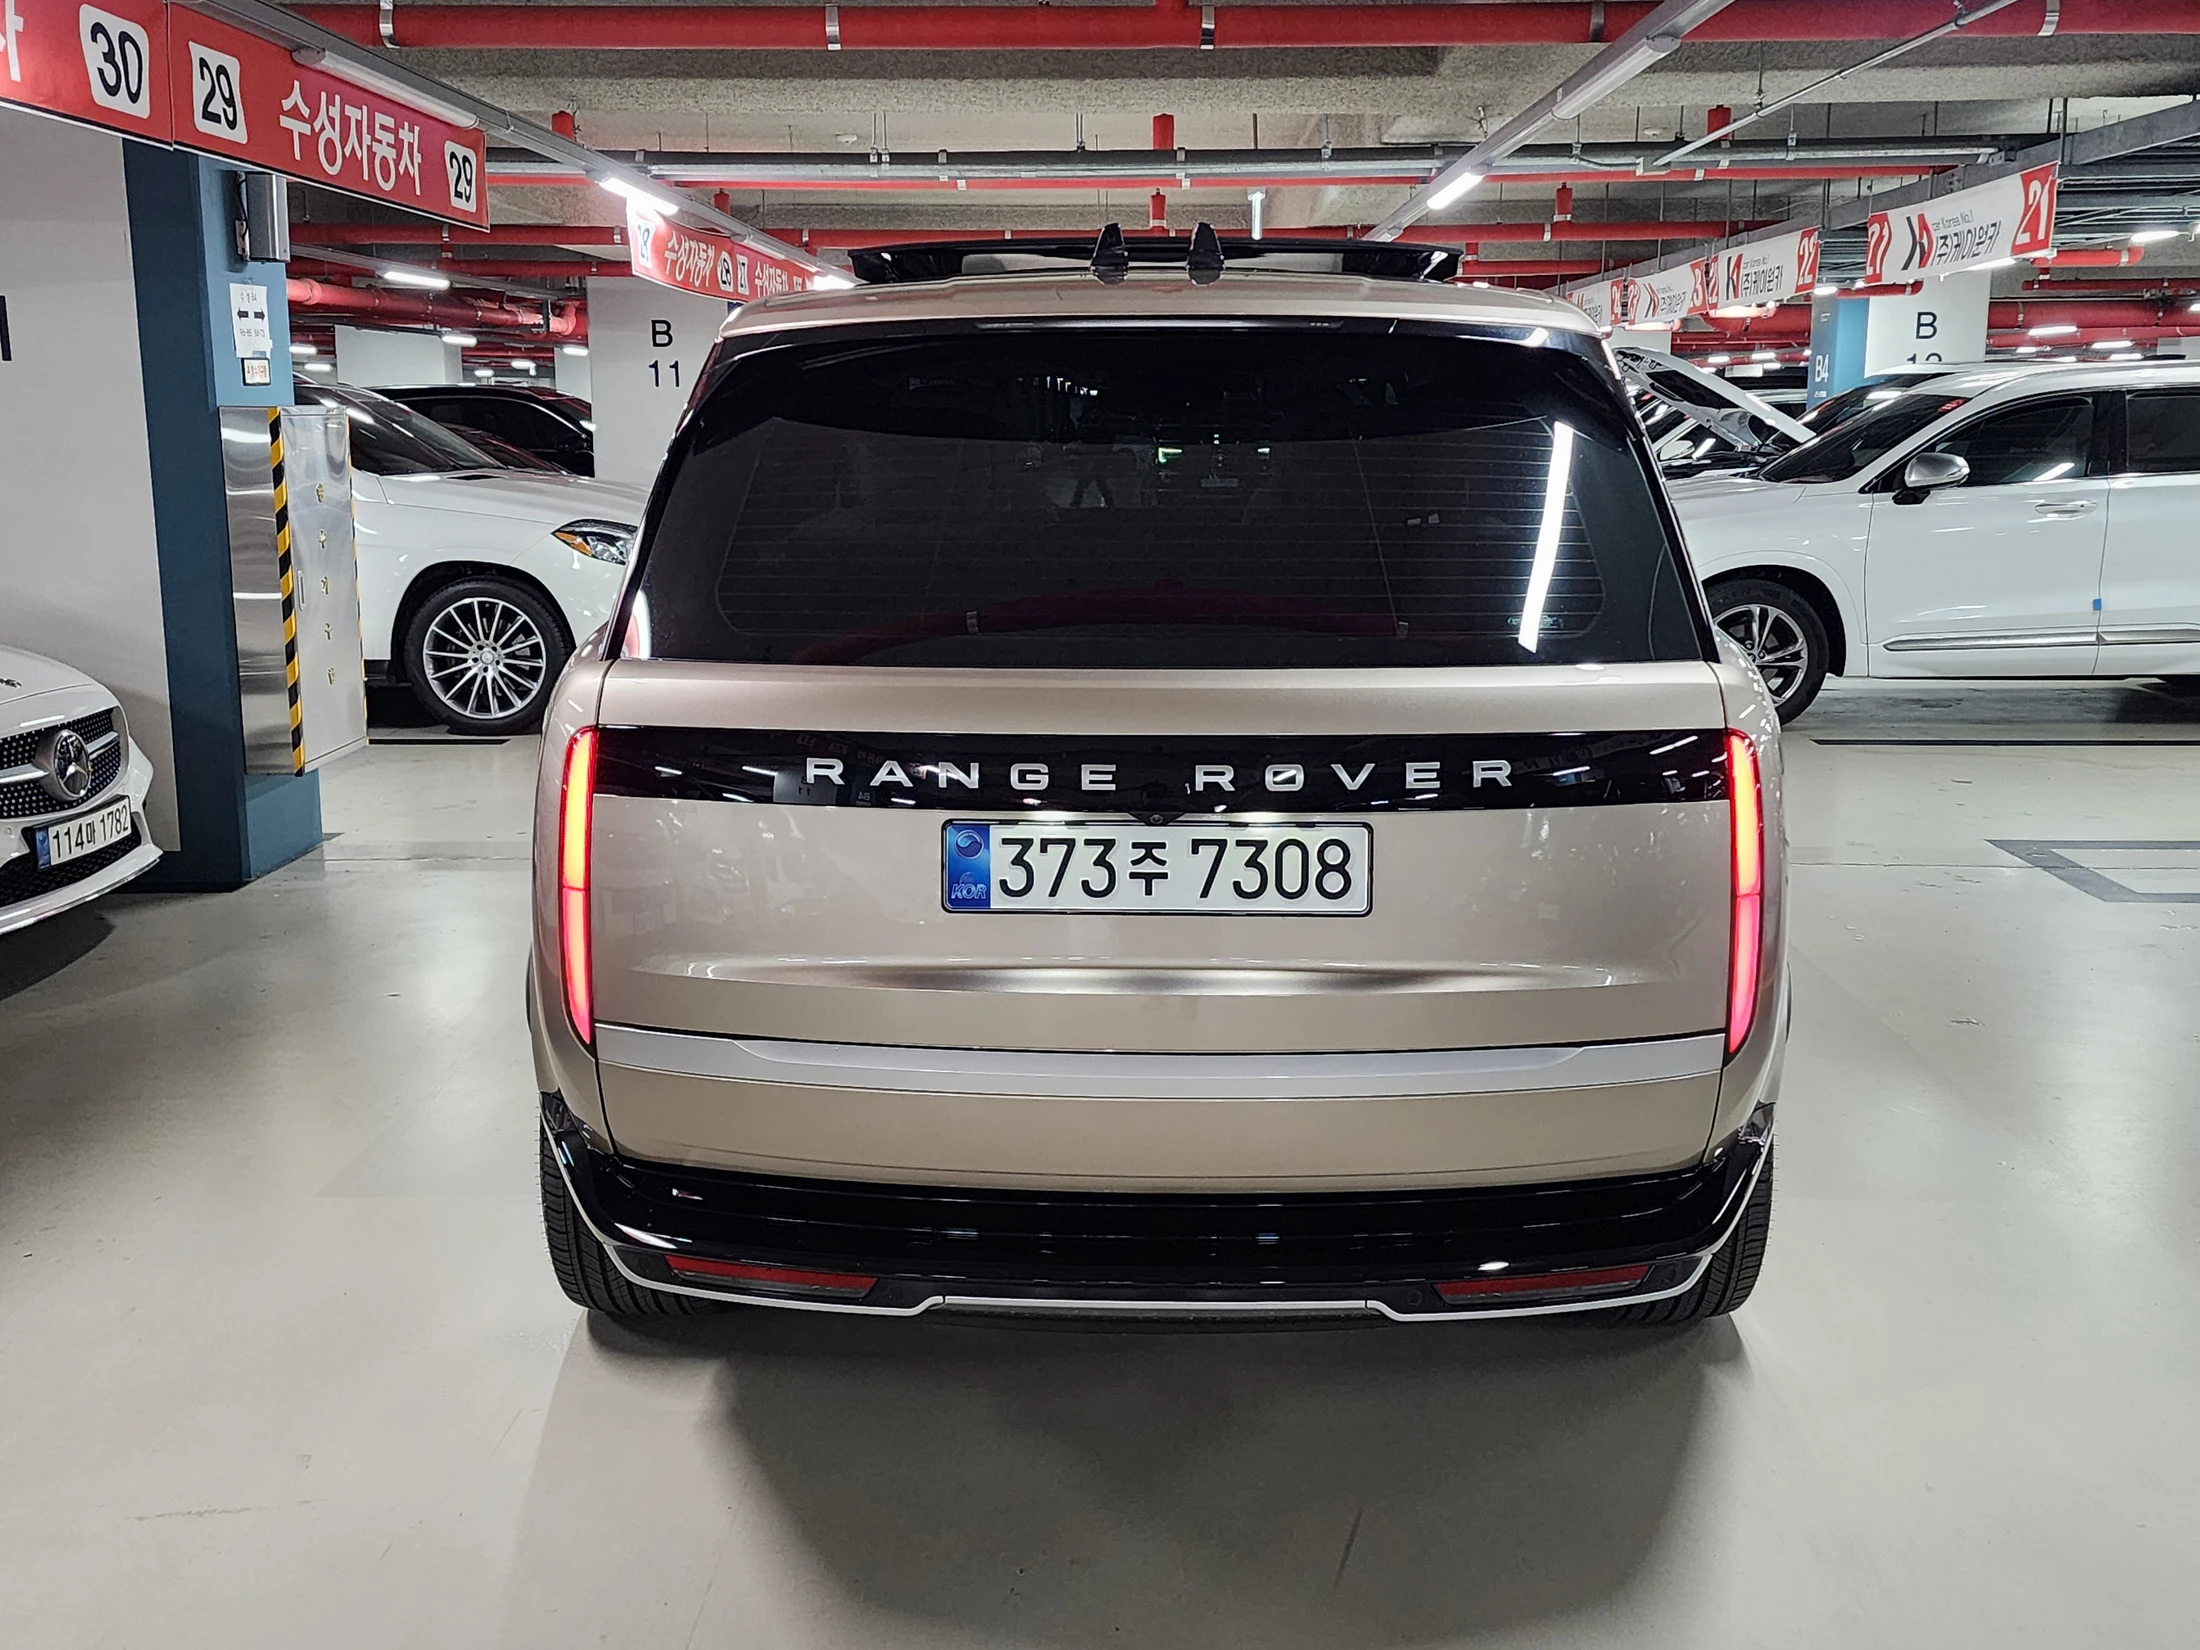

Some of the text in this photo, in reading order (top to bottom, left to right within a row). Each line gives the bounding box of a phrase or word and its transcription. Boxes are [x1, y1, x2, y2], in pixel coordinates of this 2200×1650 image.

[90, 22, 143, 104] 30
[199, 57, 473, 203] 29 수성자동차 29
[1866, 222, 1888, 276] 21
[2014, 175, 2052, 246] 21
[664, 231, 715, 287] 수성자동차
[1797, 230, 1818, 286] 22
[651, 320, 673, 347] B
[1916, 312, 1937, 339] B
[649, 360, 680, 387] 11
[1814, 354, 1829, 383] B4
[806, 757, 1117, 790] RANGE
[1195, 760, 1512, 791] ROVER
[53, 804, 129, 858] 114마 1782
[951, 884, 987, 899] KOR
[999, 838, 1352, 900] 373주 7308
